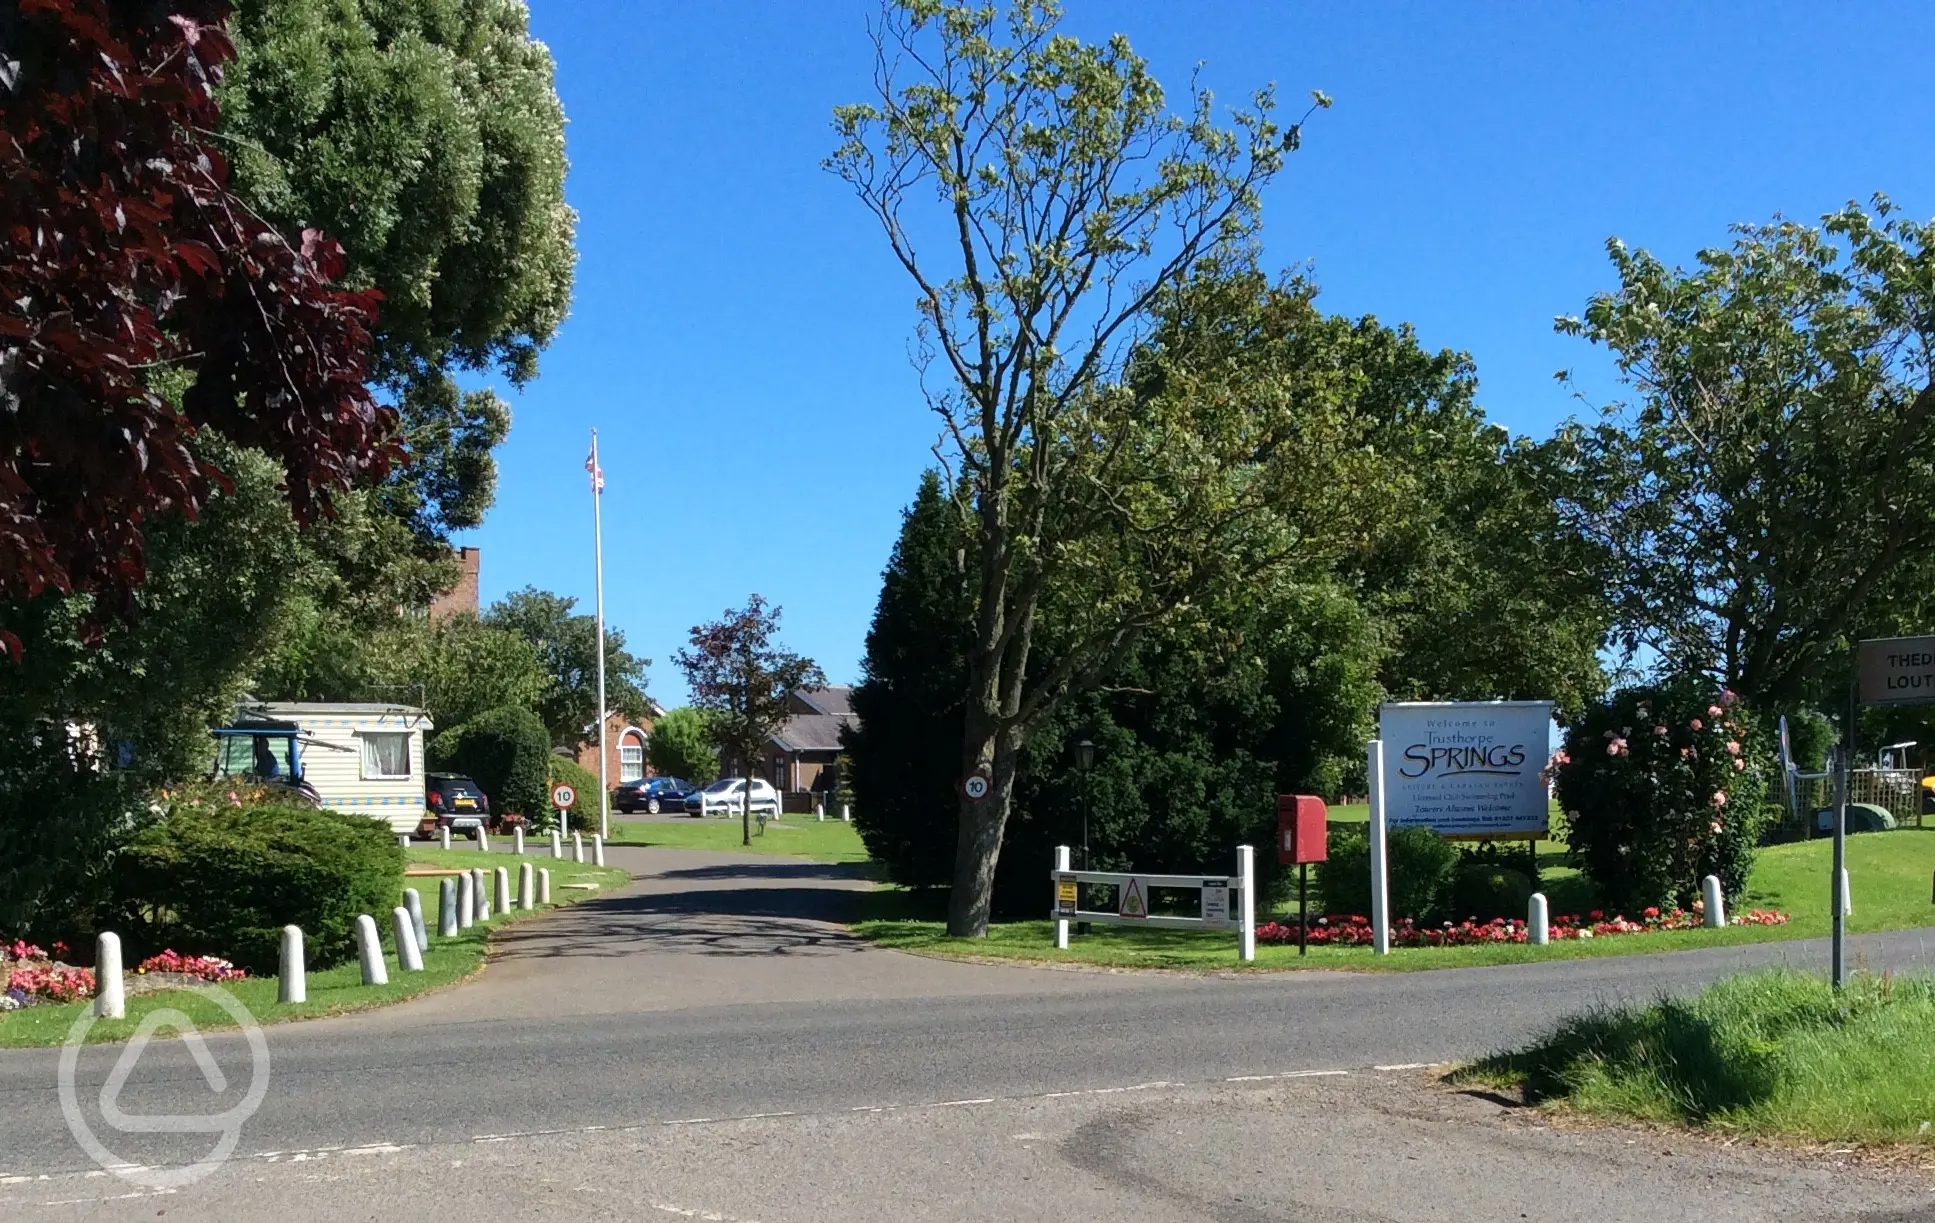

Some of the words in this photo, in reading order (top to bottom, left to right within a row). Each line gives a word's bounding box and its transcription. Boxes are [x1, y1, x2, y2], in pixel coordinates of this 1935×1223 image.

[1887, 651, 1935, 668] THED
[1888, 674, 1935, 690] LOUT
[1427, 719, 1477, 728] Welcome
[1484, 719, 1496, 728] to
[1423, 730, 1494, 748] Trusthorpe
[1399, 743, 1526, 778] SPRINGS
[969, 781, 983, 793] 10
[557, 791, 571, 801] 10
[1477, 804, 1511, 812] Welcome
